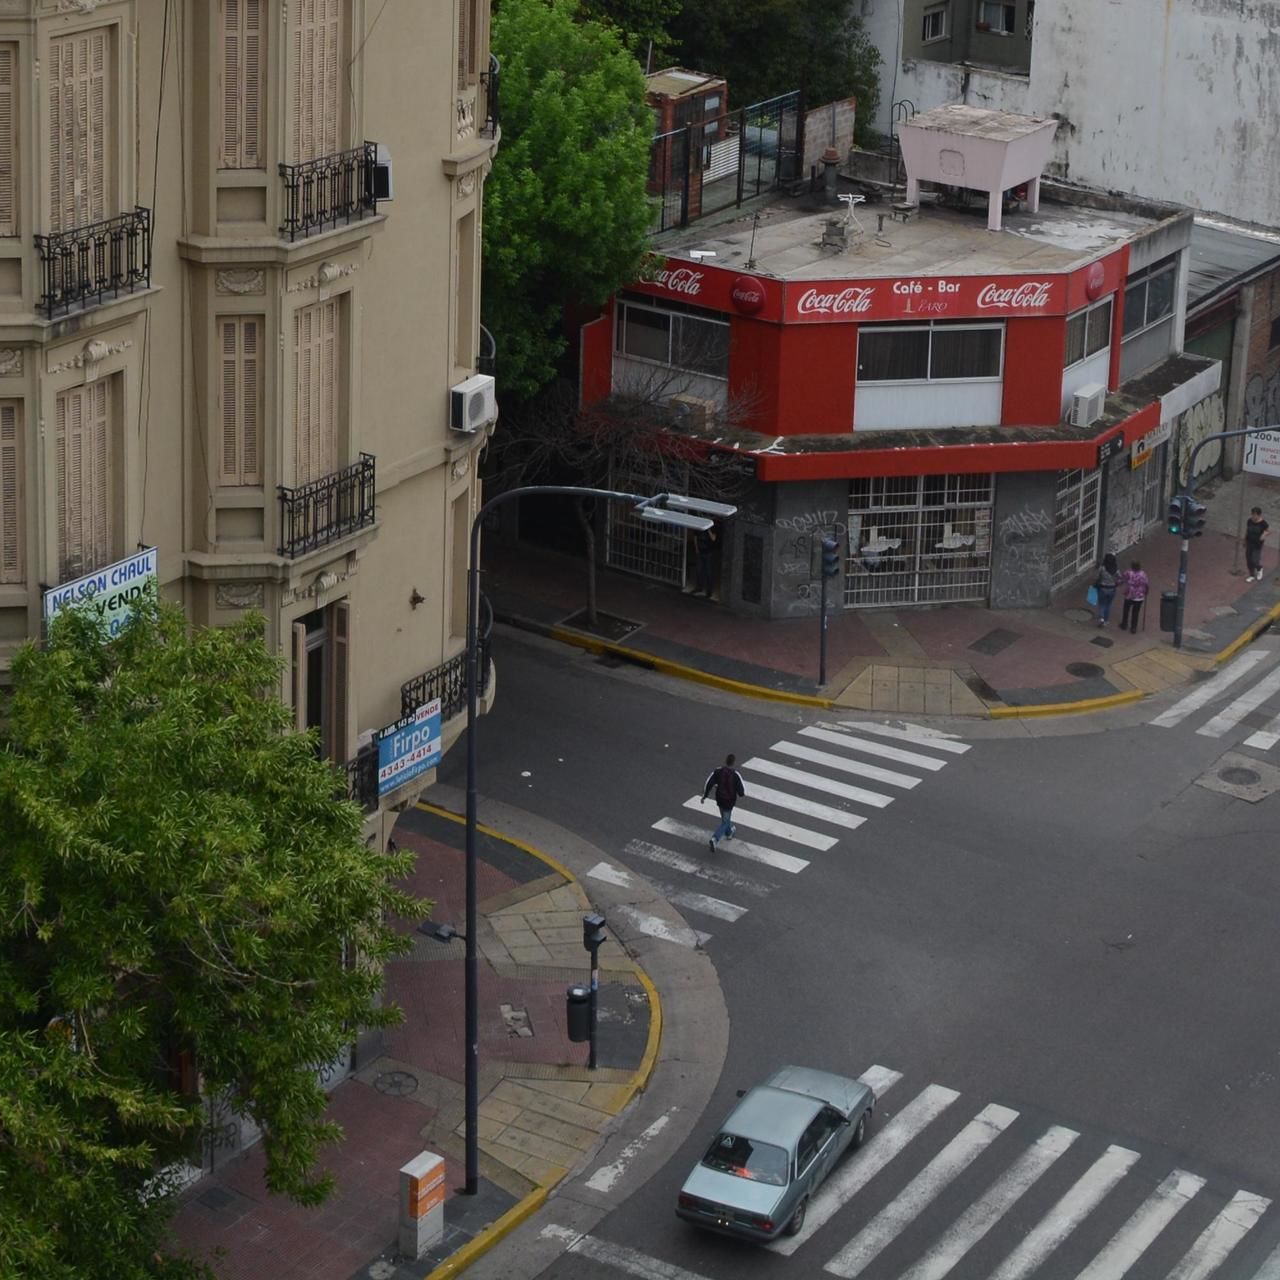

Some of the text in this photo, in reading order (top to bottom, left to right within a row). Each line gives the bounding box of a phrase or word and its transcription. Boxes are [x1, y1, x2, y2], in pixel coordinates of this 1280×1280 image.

[797, 287, 876, 314] Coca-Cola
[893, 280, 923, 294] Café
[938, 280, 961, 293] Bar
[976, 282, 1054, 309] Coca-Cola
[1254, 432, 1272, 441] 200
[111, 556, 152, 586] CHAUL
[416, 703, 439, 721] VENDE
[393, 726, 430, 758] Firpo
[381, 745, 432, 778] 4343-4414
